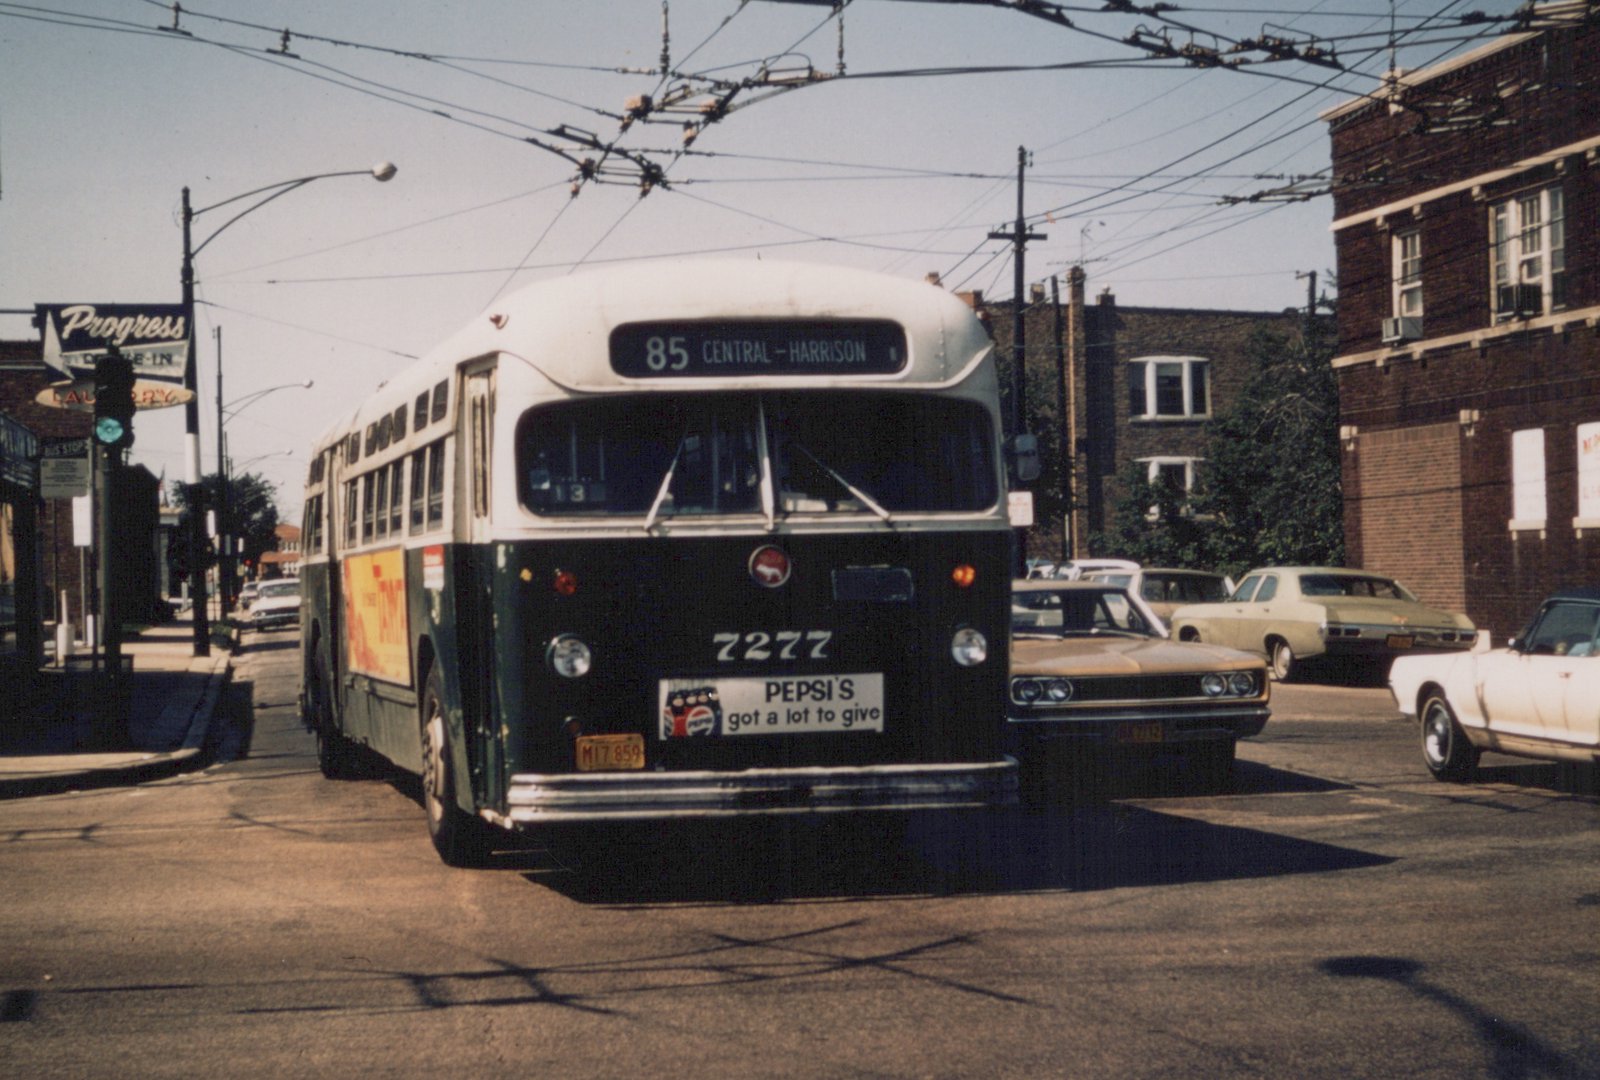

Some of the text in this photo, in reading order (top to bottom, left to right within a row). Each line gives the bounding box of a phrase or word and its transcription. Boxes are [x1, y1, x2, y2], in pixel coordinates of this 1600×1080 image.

[61, 305, 185, 345] Progress
[646, 336, 689, 371] 85
[703, 340, 772, 364] CENTRAL
[790, 340, 867, 363] HARRISON
[713, 630, 832, 661] 7277
[765, 677, 855, 703] PEPSI'S
[728, 703, 880, 731] got a lot to give
[614, 744, 640, 763] 859
